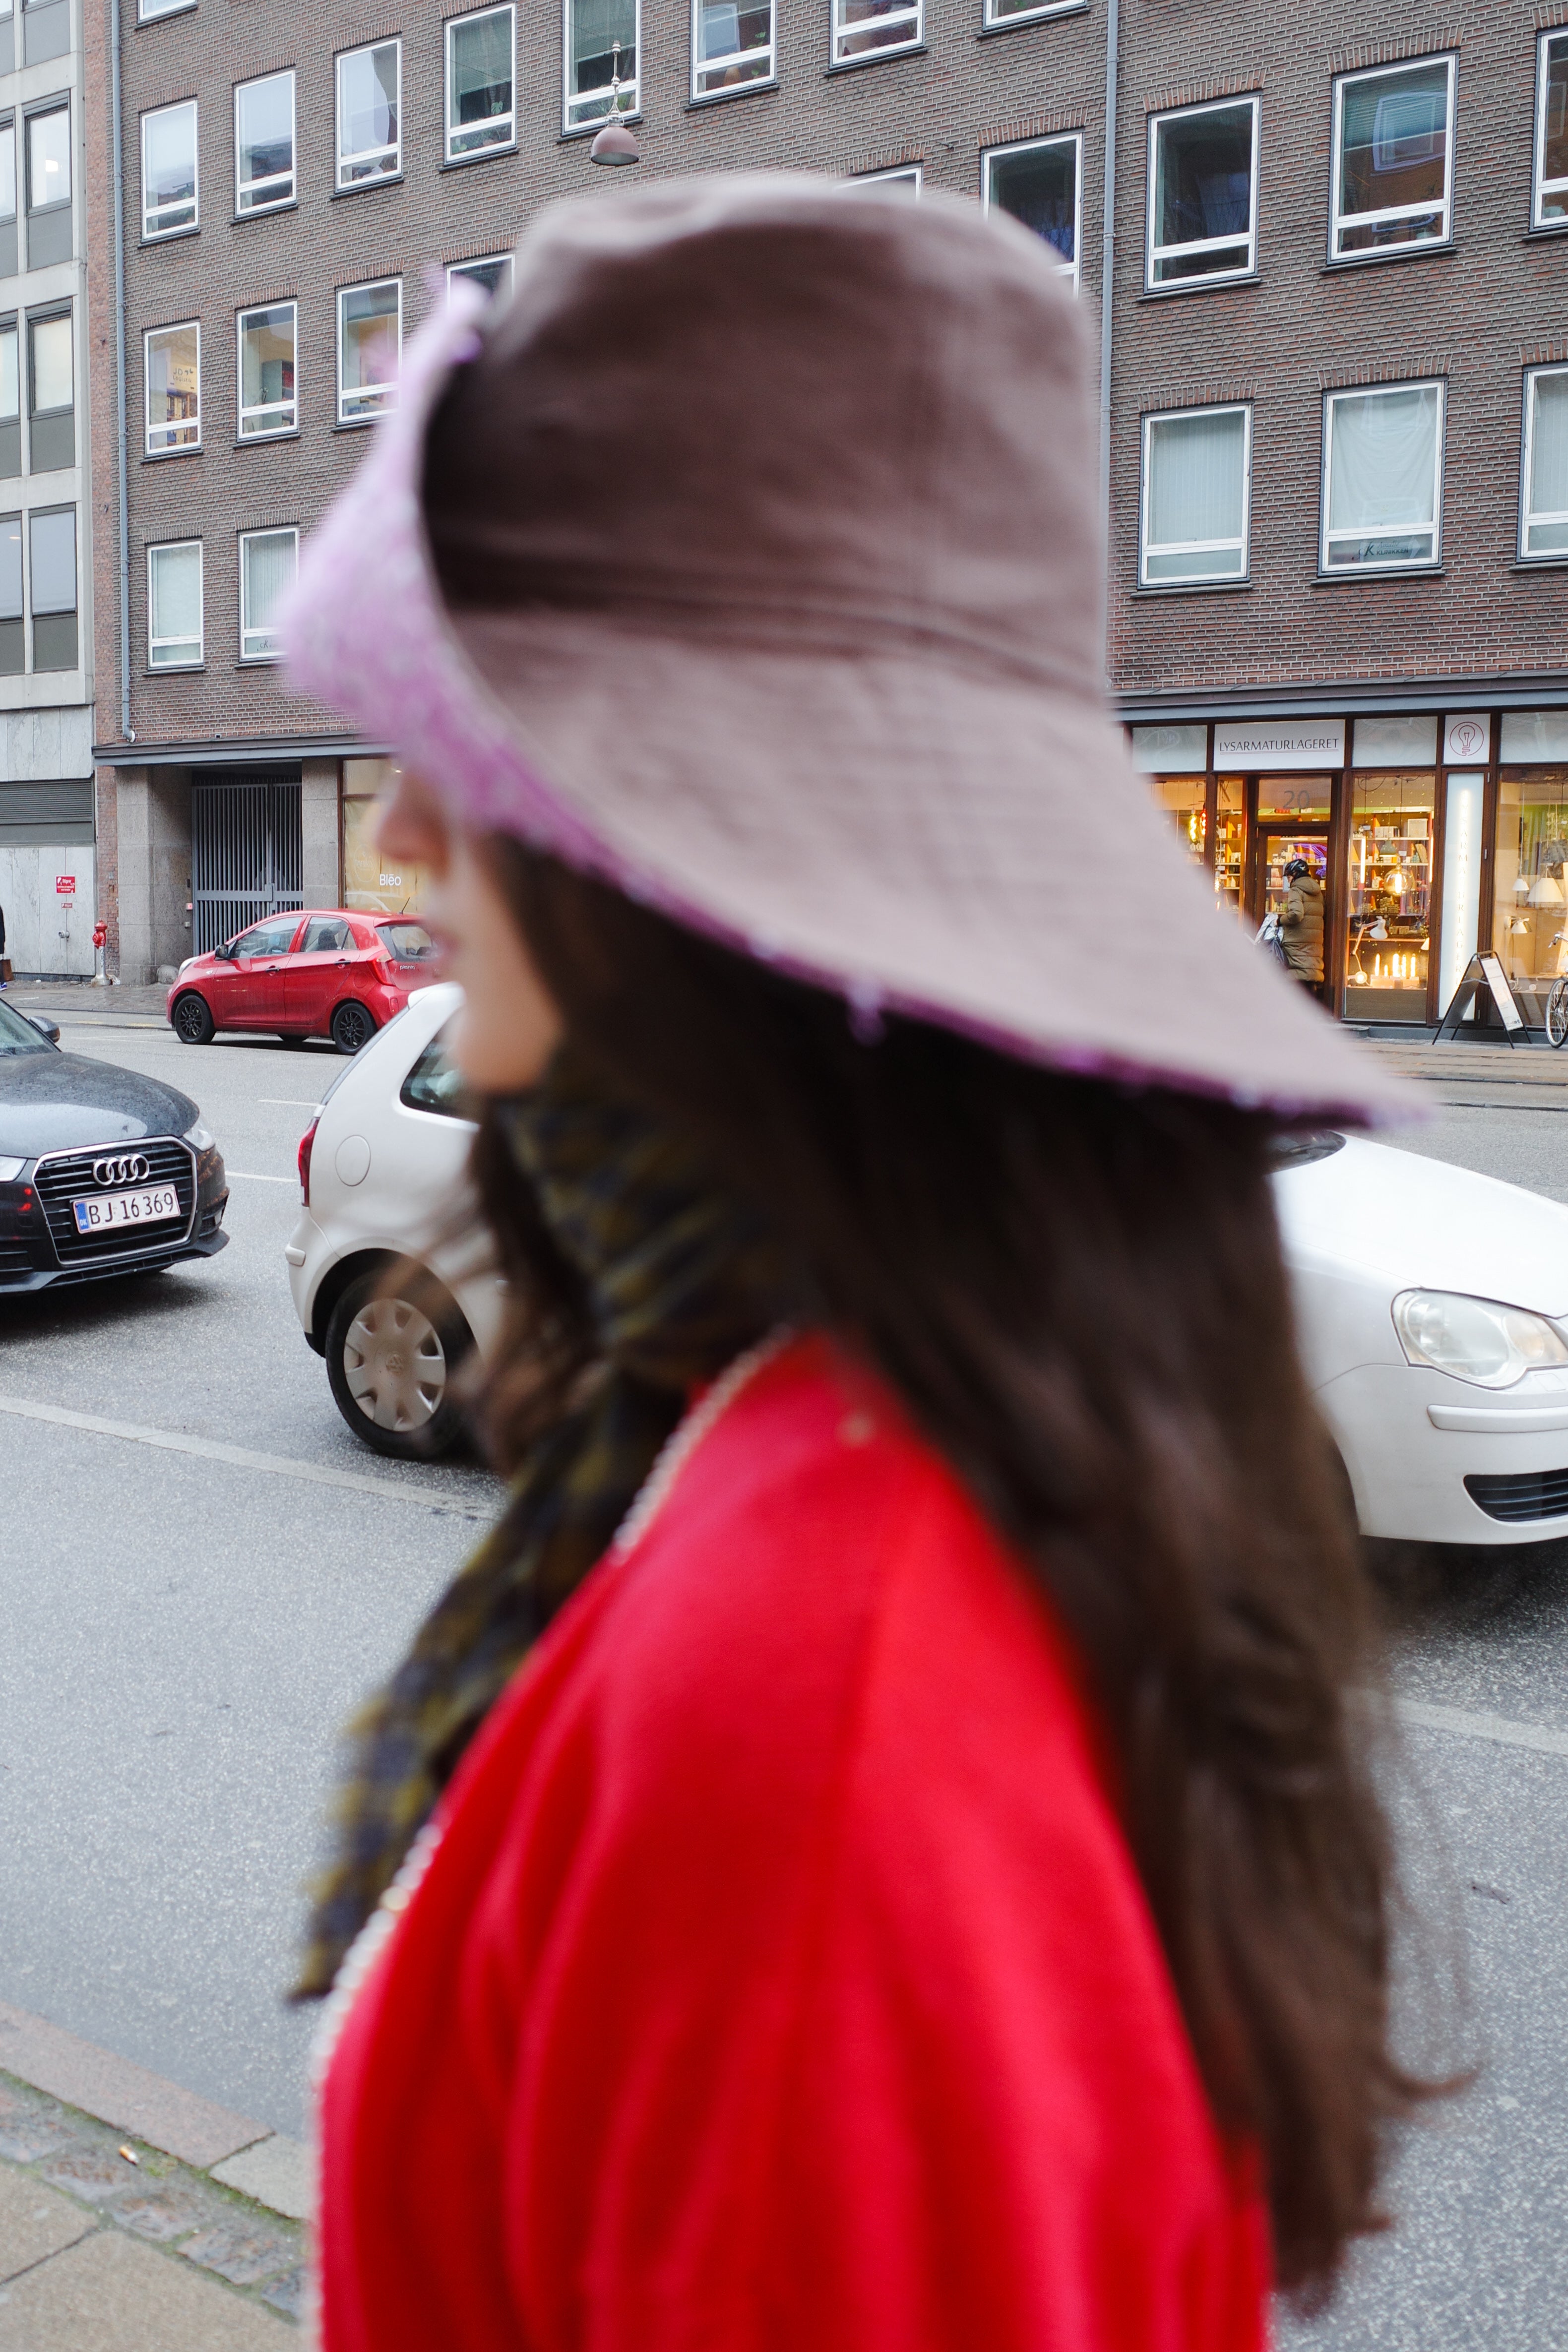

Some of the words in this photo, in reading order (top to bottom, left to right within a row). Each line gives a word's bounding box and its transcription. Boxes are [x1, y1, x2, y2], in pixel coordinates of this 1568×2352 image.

[1220, 738, 1339, 752] LYSARMATURLAGERET
[1283, 790, 1310, 809] 20
[121, 1197, 139, 1220] 16
[143, 1192, 174, 1215] 369
